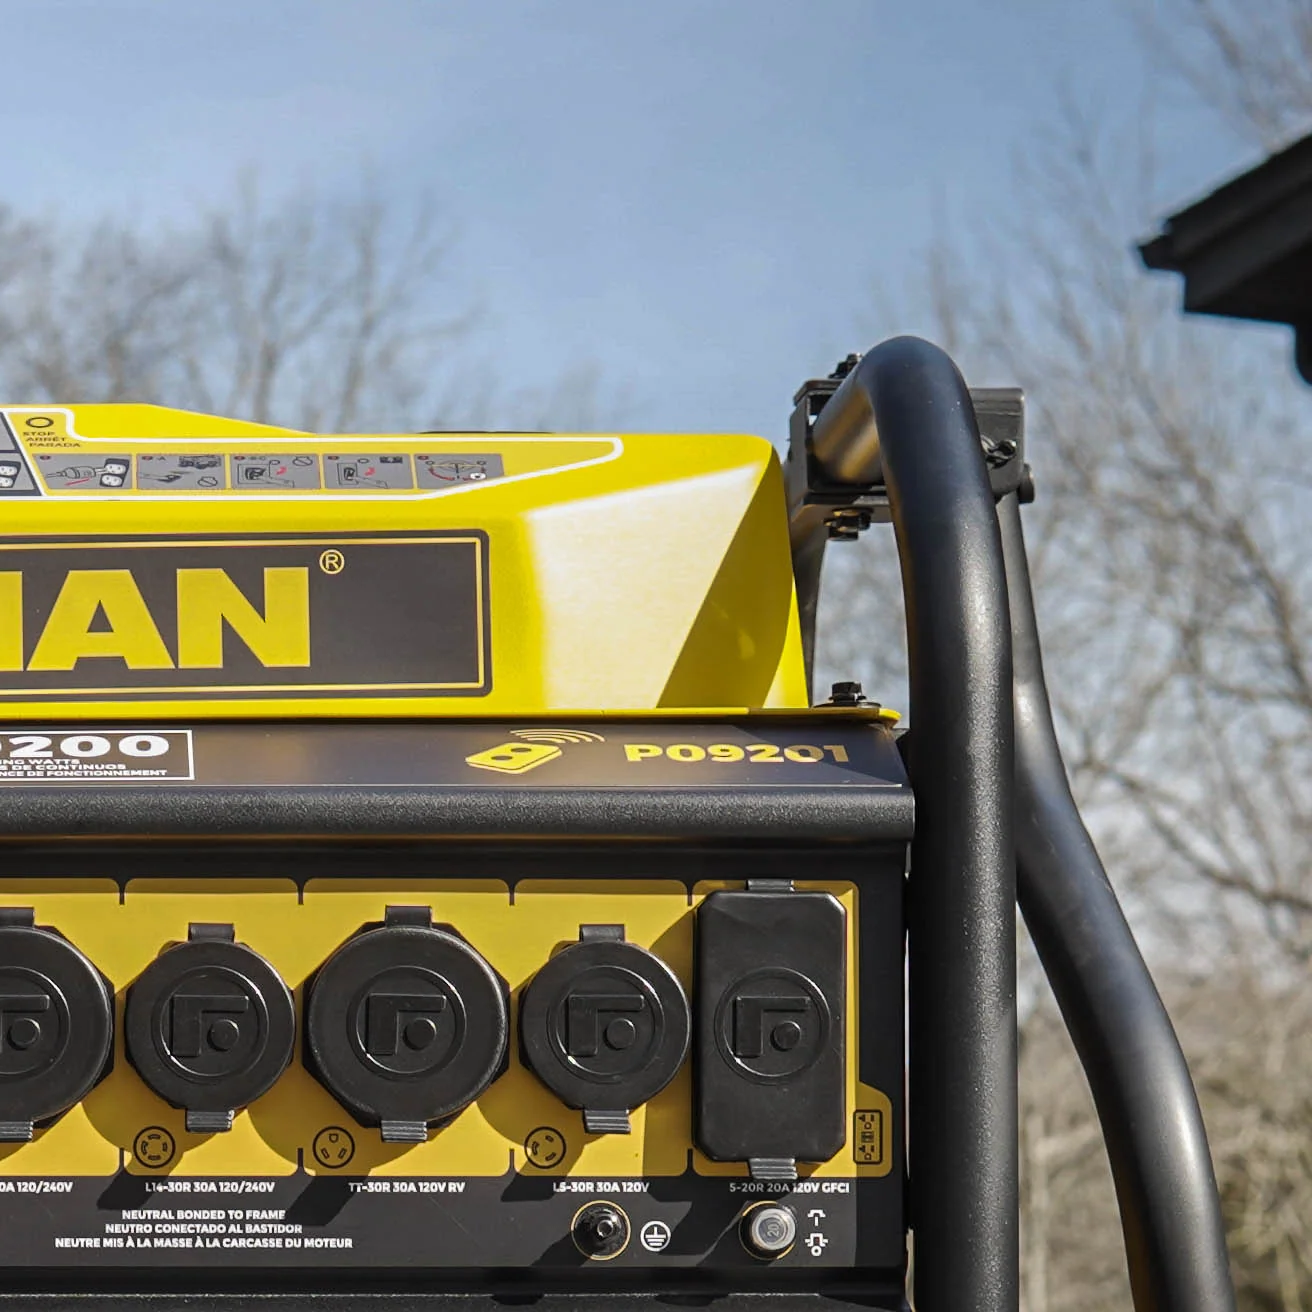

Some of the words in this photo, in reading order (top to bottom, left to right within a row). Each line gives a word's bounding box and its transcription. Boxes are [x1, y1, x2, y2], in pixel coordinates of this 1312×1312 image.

[624, 743, 848, 762] P09201
[16, 1181, 73, 1193] 120/240V
[145, 1181, 191, 1192] L14-30R
[193, 1181, 217, 1192] 30A
[218, 1181, 275, 1193] 120/240V
[348, 1181, 390, 1192] TT-30R
[392, 1181, 417, 1192] 30A
[417, 1181, 446, 1192] 120V
[447, 1181, 465, 1192] RV
[729, 1182, 768, 1192] 5-20R
[768, 1183, 789, 1192] 20A
[792, 1182, 820, 1193] 120V
[821, 1182, 849, 1193] GFCI
[122, 1209, 174, 1219] NEUTRAL
[176, 1209, 225, 1219] BONDED
[227, 1209, 243, 1219] TO
[245, 1209, 285, 1219] FRAME
[105, 1223, 152, 1233] NEUTRO
[154, 1223, 226, 1233] CONECTADO
[227, 1223, 243, 1233] AL
[245, 1223, 302, 1233] BASTIDOR
[54, 1237, 100, 1247] NEUTRE
[102, 1237, 124, 1247] MIS
[125, 1235, 135, 1247] À
[136, 1238, 151, 1247] LA
[153, 1237, 192, 1247] MASSE
[194, 1235, 204, 1247] À
[205, 1238, 220, 1247] LA
[222, 1237, 282, 1248] CARCASSE
[284, 1238, 301, 1248] DU
[304, 1237, 352, 1248] MOTEUR
